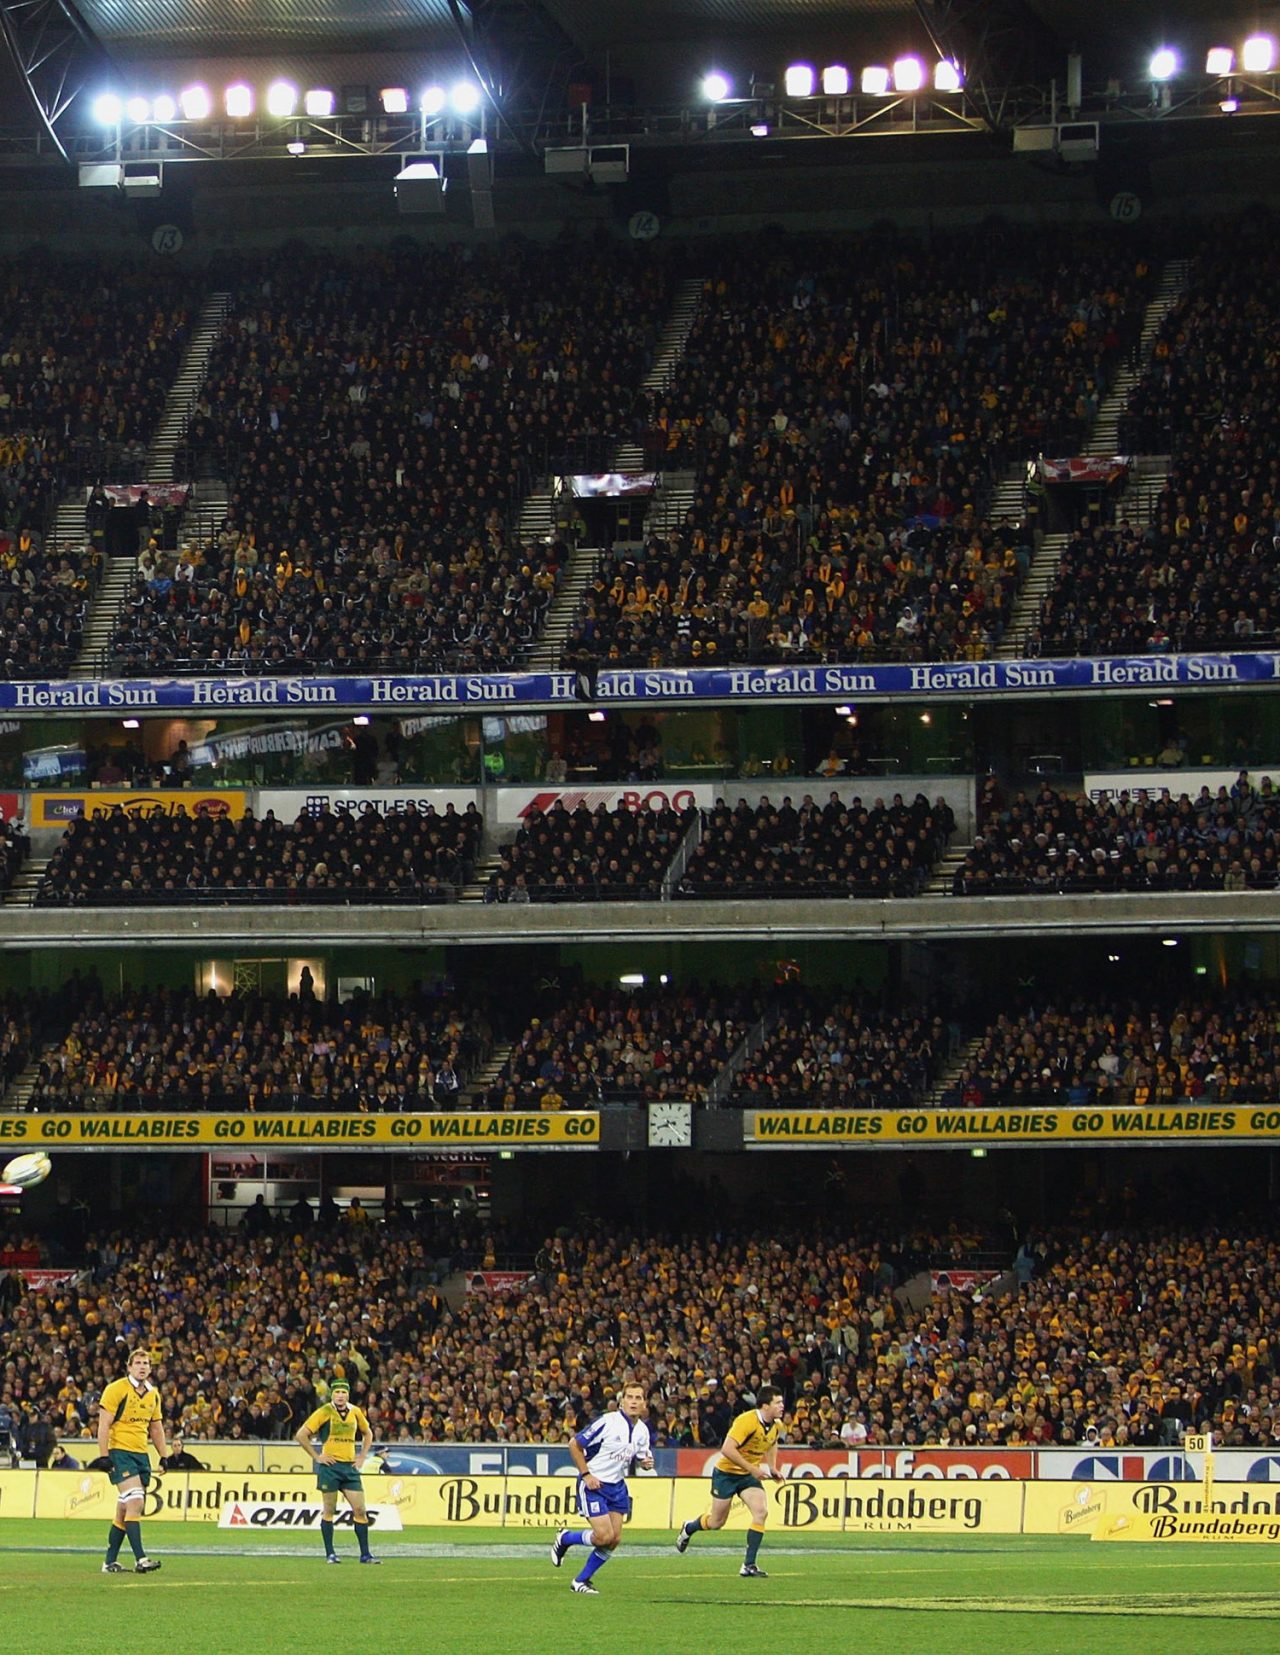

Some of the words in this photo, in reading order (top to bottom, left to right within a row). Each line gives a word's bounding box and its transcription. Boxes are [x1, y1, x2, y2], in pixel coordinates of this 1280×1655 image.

[729, 672, 816, 693] Herald
[824, 670, 876, 692] Sun
[910, 667, 997, 689] Herald
[1005, 666, 1056, 687] Sun
[1090, 663, 1179, 685] Herald
[1186, 661, 1238, 682] Sun
[15, 684, 100, 705] Herald
[109, 683, 158, 704] Sun
[192, 681, 278, 702] Herald
[286, 680, 336, 702] Sun
[370, 679, 458, 700] Herald
[466, 678, 516, 699] Sun
[550, 675, 637, 698] Hald
[645, 674, 695, 696] Sun
[42, 1120, 71, 1137] GO
[80, 1120, 199, 1137] WALLABIES
[215, 1120, 245, 1137] GO
[254, 1120, 376, 1137] WALLABIES
[391, 1119, 422, 1136] GO
[430, 1119, 550, 1136] WALLABIES
[565, 1118, 595, 1135] GO
[760, 1116, 882, 1134] WALLABIES
[897, 1116, 928, 1133] GO
[936, 1114, 1058, 1133] WALLABIES
[1072, 1114, 1104, 1131] GO
[1112, 1112, 1236, 1131] WALLABIES
[1250, 1111, 1280, 1130] GO
[1188, 1438, 1204, 1450] 50
[774, 1482, 982, 1528] Bundaberg
[1064, 1501, 1102, 1525] Bundaberg
[523, 1518, 568, 1527] RUM
[863, 1522, 913, 1531] RUM
[1150, 1515, 1279, 1540] Bundaberg
